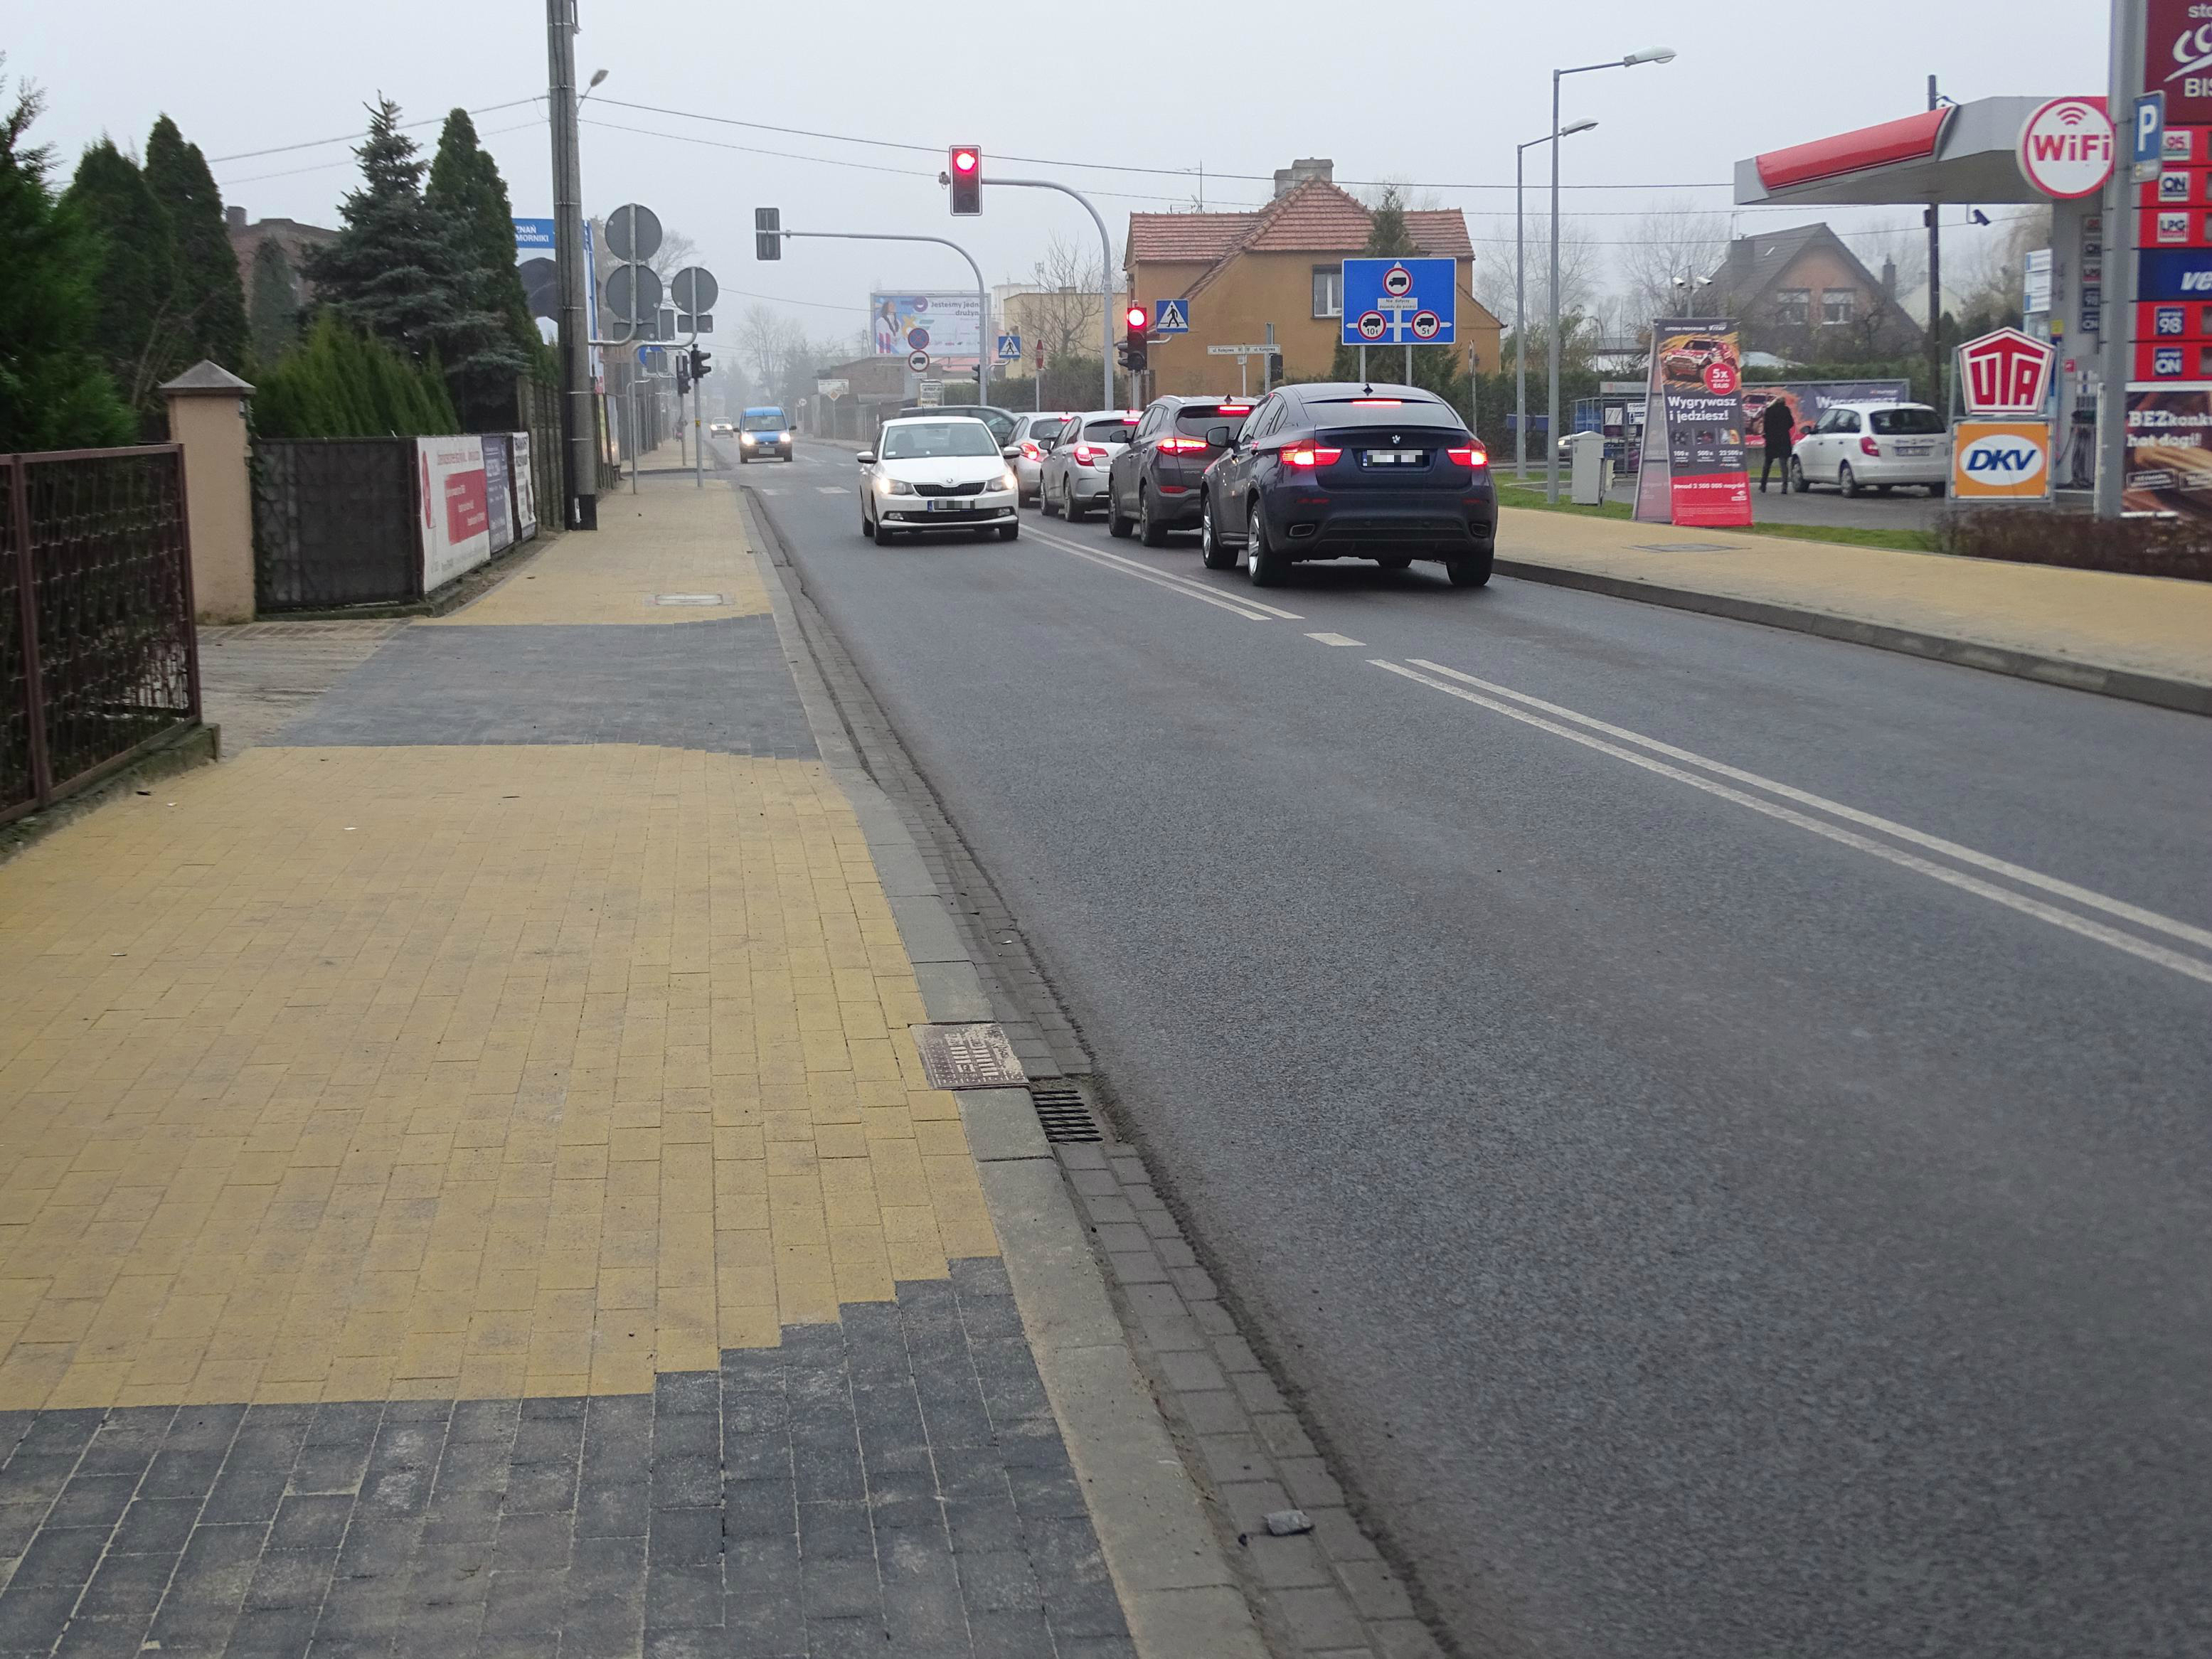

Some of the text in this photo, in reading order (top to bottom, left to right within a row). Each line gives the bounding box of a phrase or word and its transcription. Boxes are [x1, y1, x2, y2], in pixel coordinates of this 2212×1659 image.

[2138, 105, 2158, 151] P
[2033, 135, 2110, 161] WiFi
[2166, 136, 2185, 150] 95
[2163, 177, 2186, 191] ON
[2161, 220, 2186, 230] LPG
[2159, 317, 2182, 334] 98
[1969, 337, 2044, 405] UTA
[2155, 358, 2181, 373] ON
[1713, 368, 1728, 378] 5x
[1667, 396, 1737, 410] Wygrywasz
[1669, 410, 1729, 423] i jedziesz!
[2127, 433, 2156, 447] hot
[1967, 449, 2036, 471] DKV
